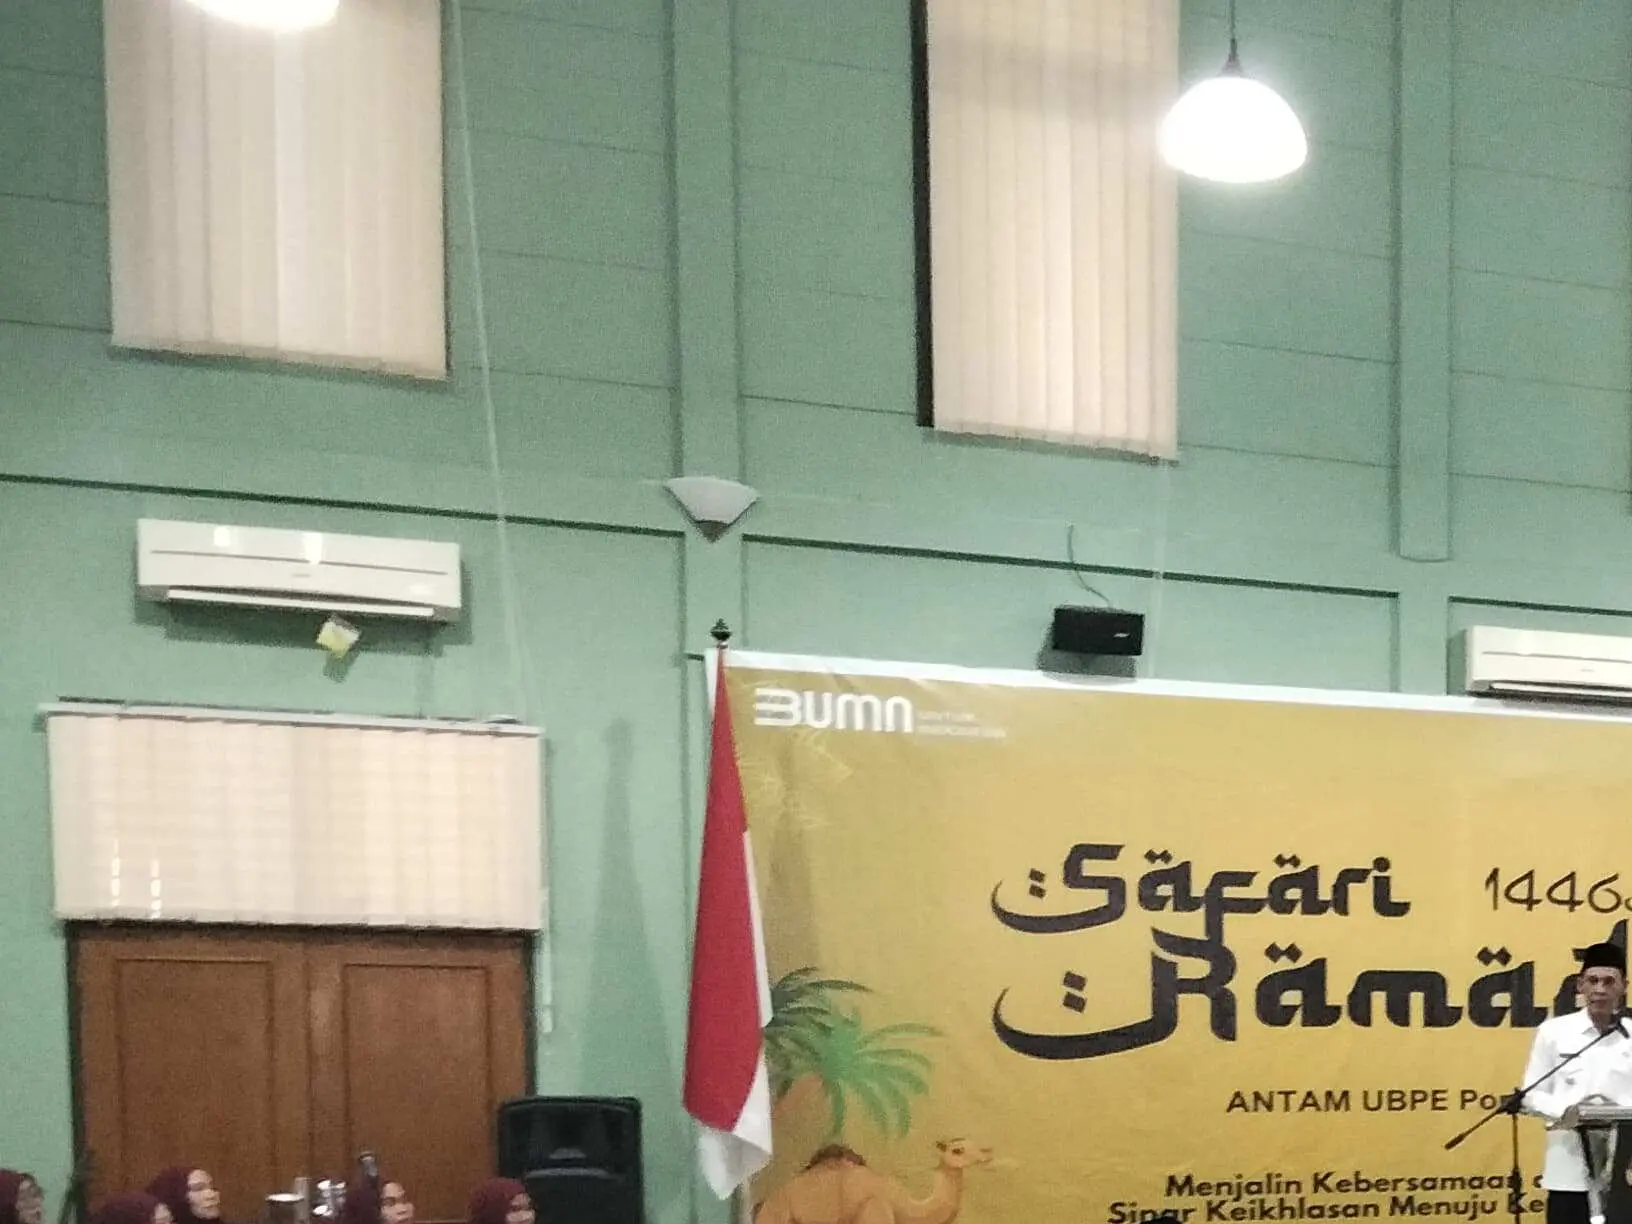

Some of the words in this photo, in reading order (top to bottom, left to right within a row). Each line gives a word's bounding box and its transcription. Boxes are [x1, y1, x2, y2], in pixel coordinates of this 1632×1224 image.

[1226, 1089, 1350, 1113] ANTAM
[1362, 1089, 1449, 1112] UBPE
[1164, 1172, 1303, 1201] Menjalin
[1206, 1197, 1380, 1222] Keikhlasan
[1388, 1194, 1498, 1221] Menuju
